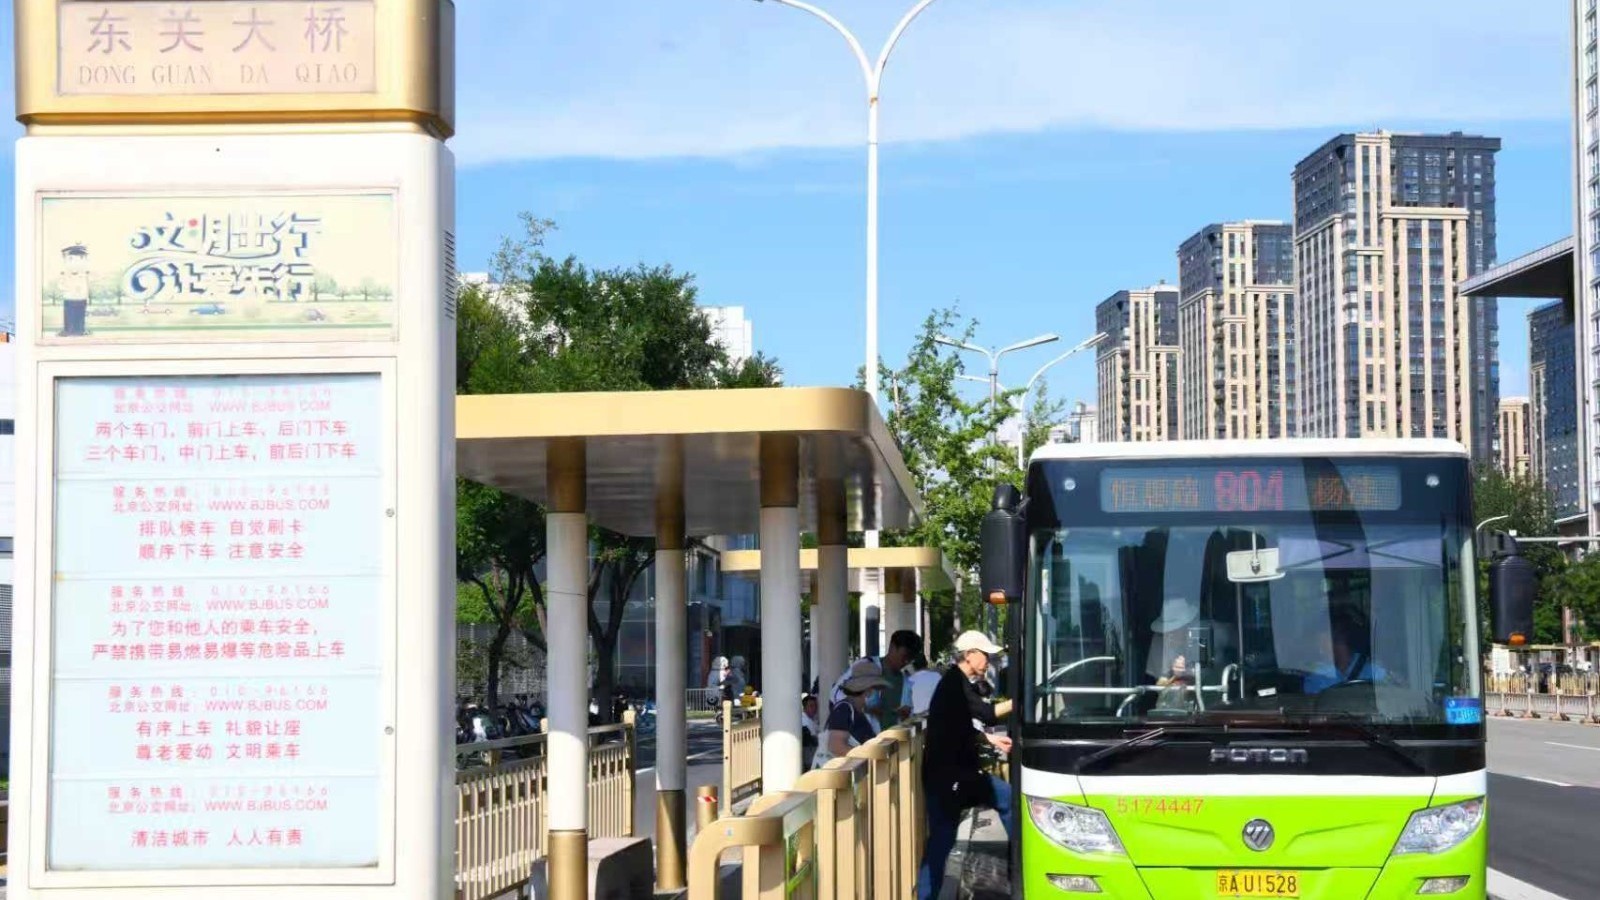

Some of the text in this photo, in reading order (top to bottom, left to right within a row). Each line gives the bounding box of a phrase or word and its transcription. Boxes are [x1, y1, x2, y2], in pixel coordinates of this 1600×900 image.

[86, 8, 349, 55] 东关大桥
[79, 63, 357, 85] DONG GUAN DA QIAO
[129, 210, 322, 258] 文明出行
[1215, 471, 1283, 511] 804
[138, 518, 305, 537] 排队候车 自觉刷卡
[137, 541, 306, 561] 顺序下车 注意安全
[91, 641, 346, 661] 严禁携带易燃易爆等危险品上车
[135, 719, 301, 738] 有序上车 礼貌让座
[135, 742, 301, 761] 尊老爱幼 文明乘车
[1210, 748, 1308, 764] FOTON
[1117, 797, 1204, 814] 5174447
[130, 827, 305, 848] 清洁城市 人人有责
